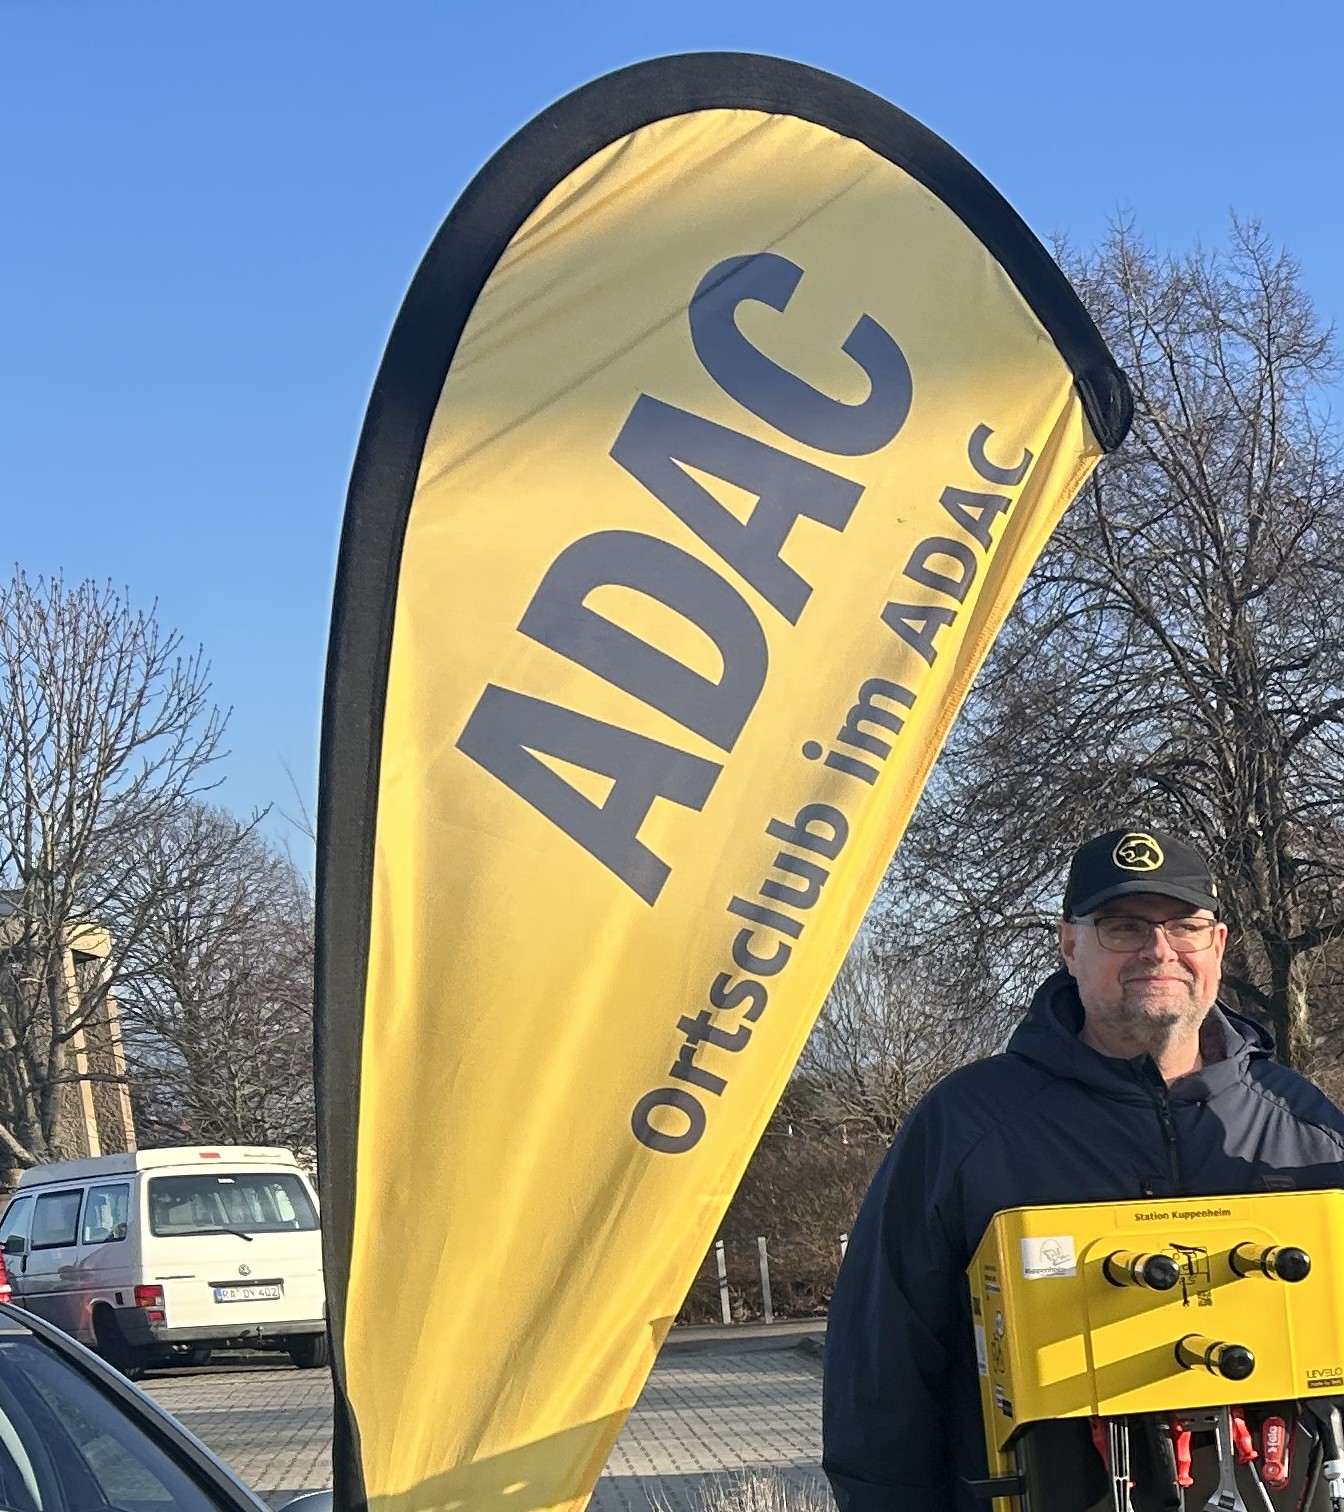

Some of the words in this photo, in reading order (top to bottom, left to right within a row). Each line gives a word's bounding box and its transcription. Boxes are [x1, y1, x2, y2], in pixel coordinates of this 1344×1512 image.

[455, 251, 913, 906] ADAC
[632, 805, 850, 1153] Ortsclub
[802, 676, 917, 784] im
[878, 422, 1035, 668] ADAC
[1134, 1211, 1169, 1221] Station
[1172, 1208, 1231, 1220] Kuppenheim
